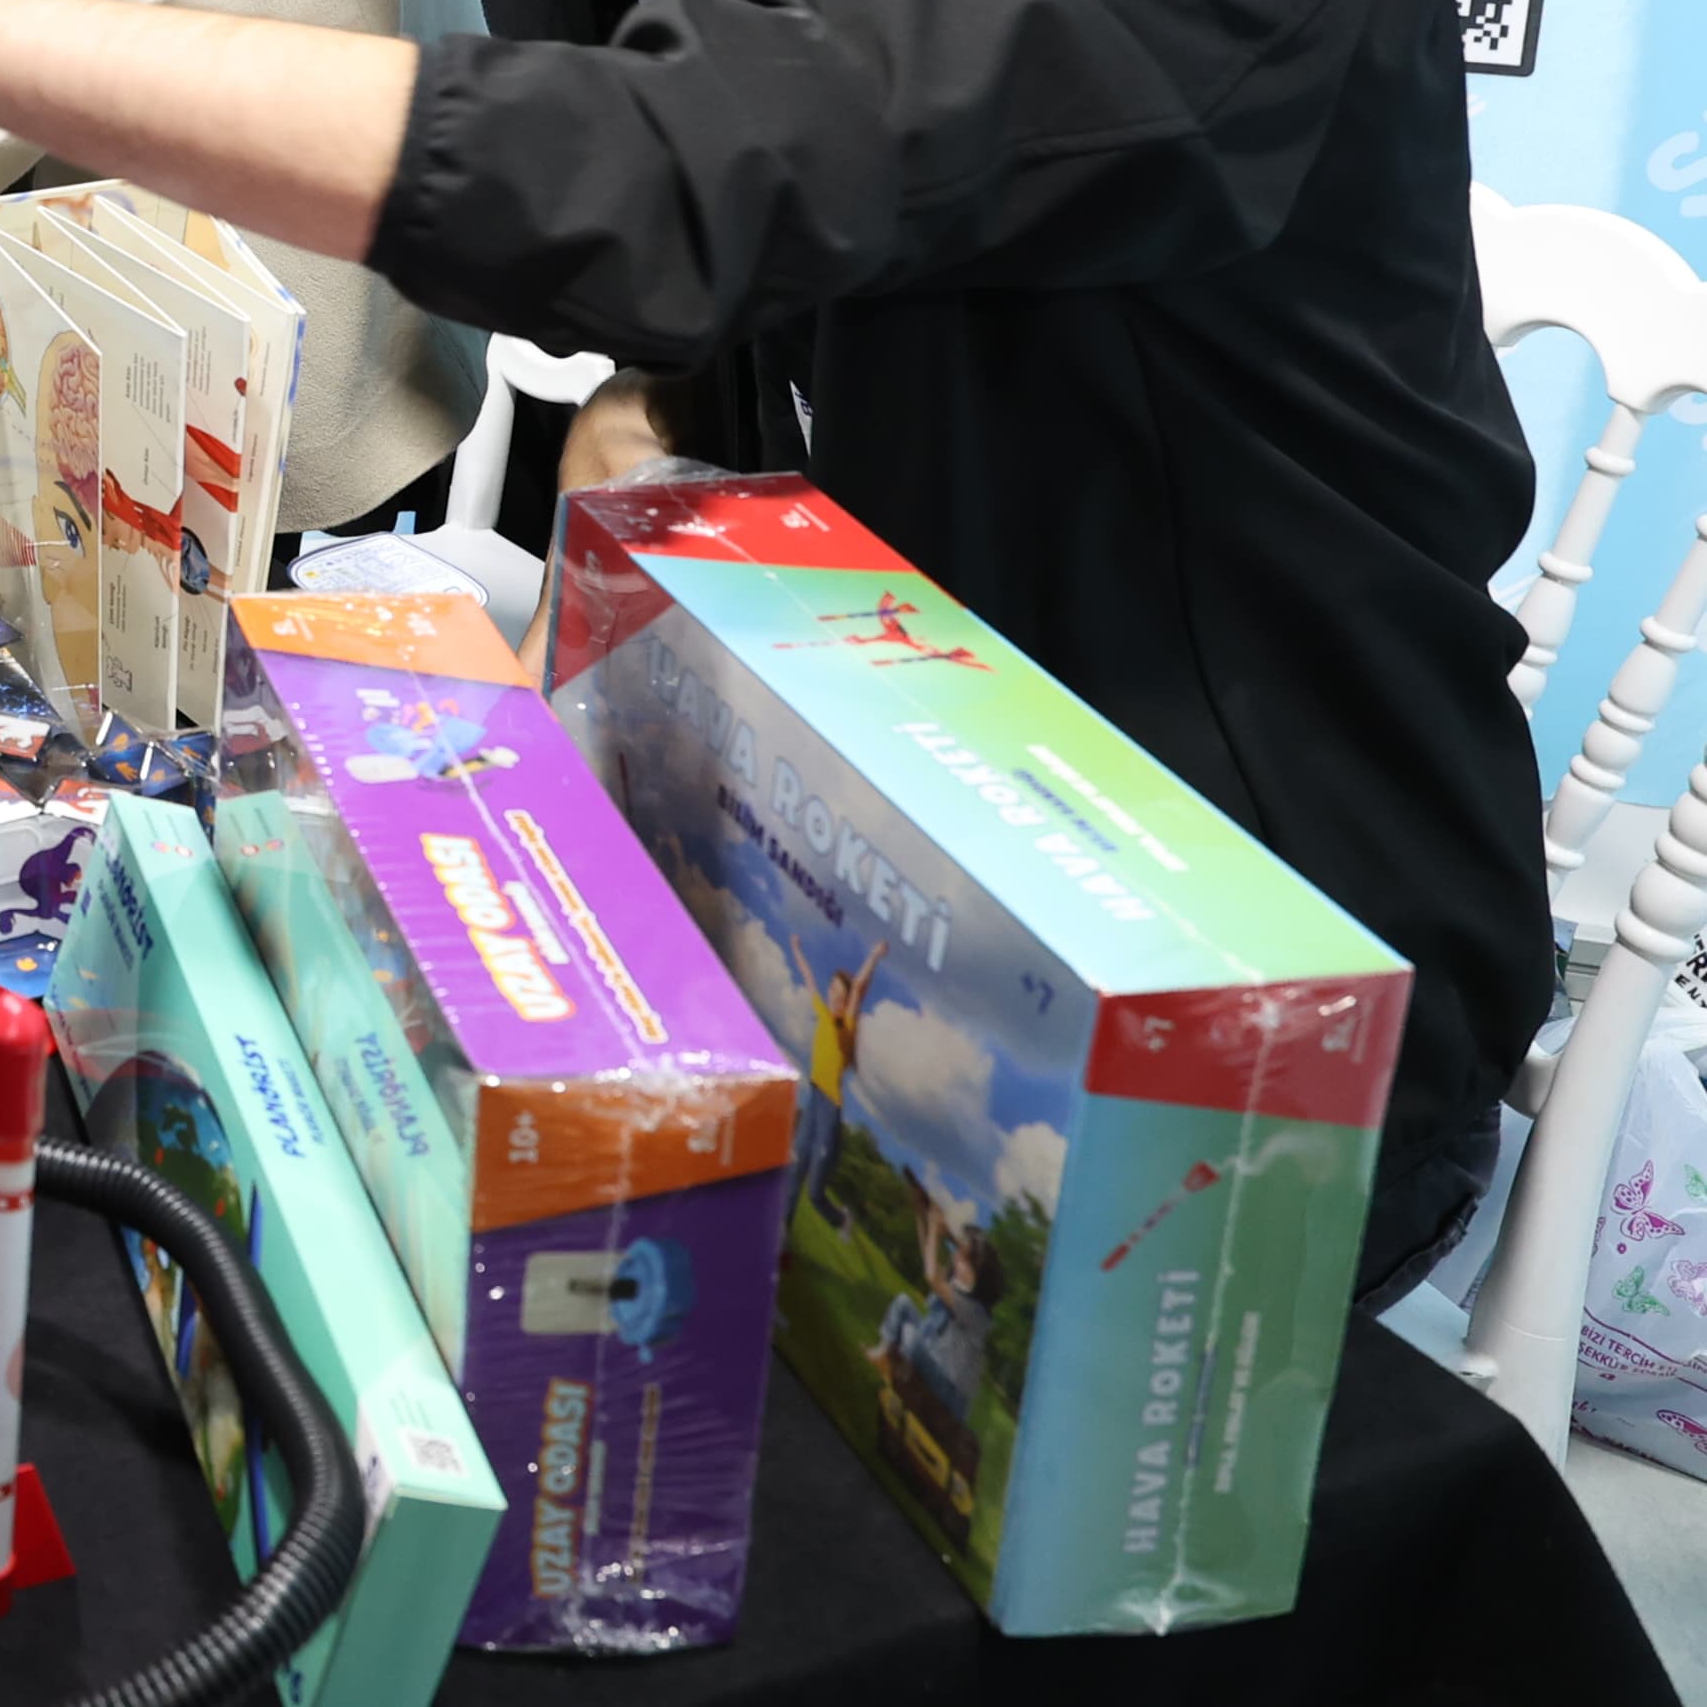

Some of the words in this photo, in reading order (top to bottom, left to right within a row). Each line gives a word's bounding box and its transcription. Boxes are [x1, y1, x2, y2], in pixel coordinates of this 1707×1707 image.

[419, 832, 510, 936] ODASI
[769, 754, 953, 973] ROKETİ
[470, 935, 575, 1022] UZAY
[508, 1109, 542, 1165] 10+
[1143, 1268, 1201, 1426] ROKETİ
[1580, 1324, 1605, 1347] BİZİ
[1608, 1337, 1656, 1370] TERCİH
[541, 1377, 590, 1496] ODASI
[534, 1496, 577, 1599] UZAY
[1122, 1436, 1172, 1557] HAVA
